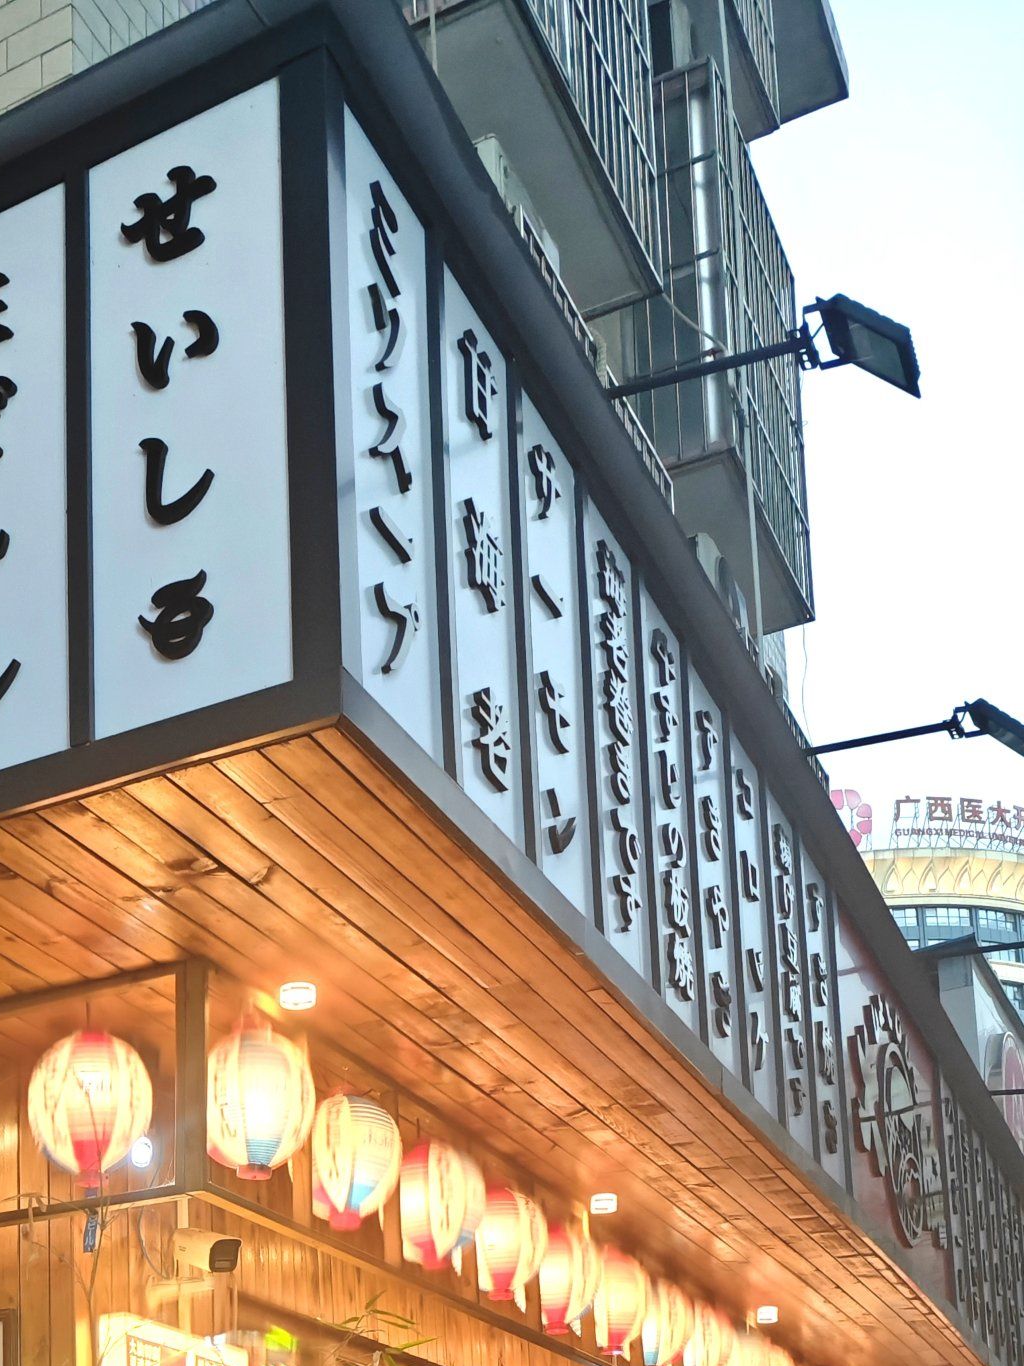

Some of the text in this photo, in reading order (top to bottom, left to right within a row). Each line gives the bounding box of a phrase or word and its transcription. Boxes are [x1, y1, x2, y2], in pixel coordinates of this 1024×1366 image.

[367, 180, 422, 675] ミソスープ
[457, 327, 508, 793] 甘海老
[527, 443, 578, 854] サーモン
